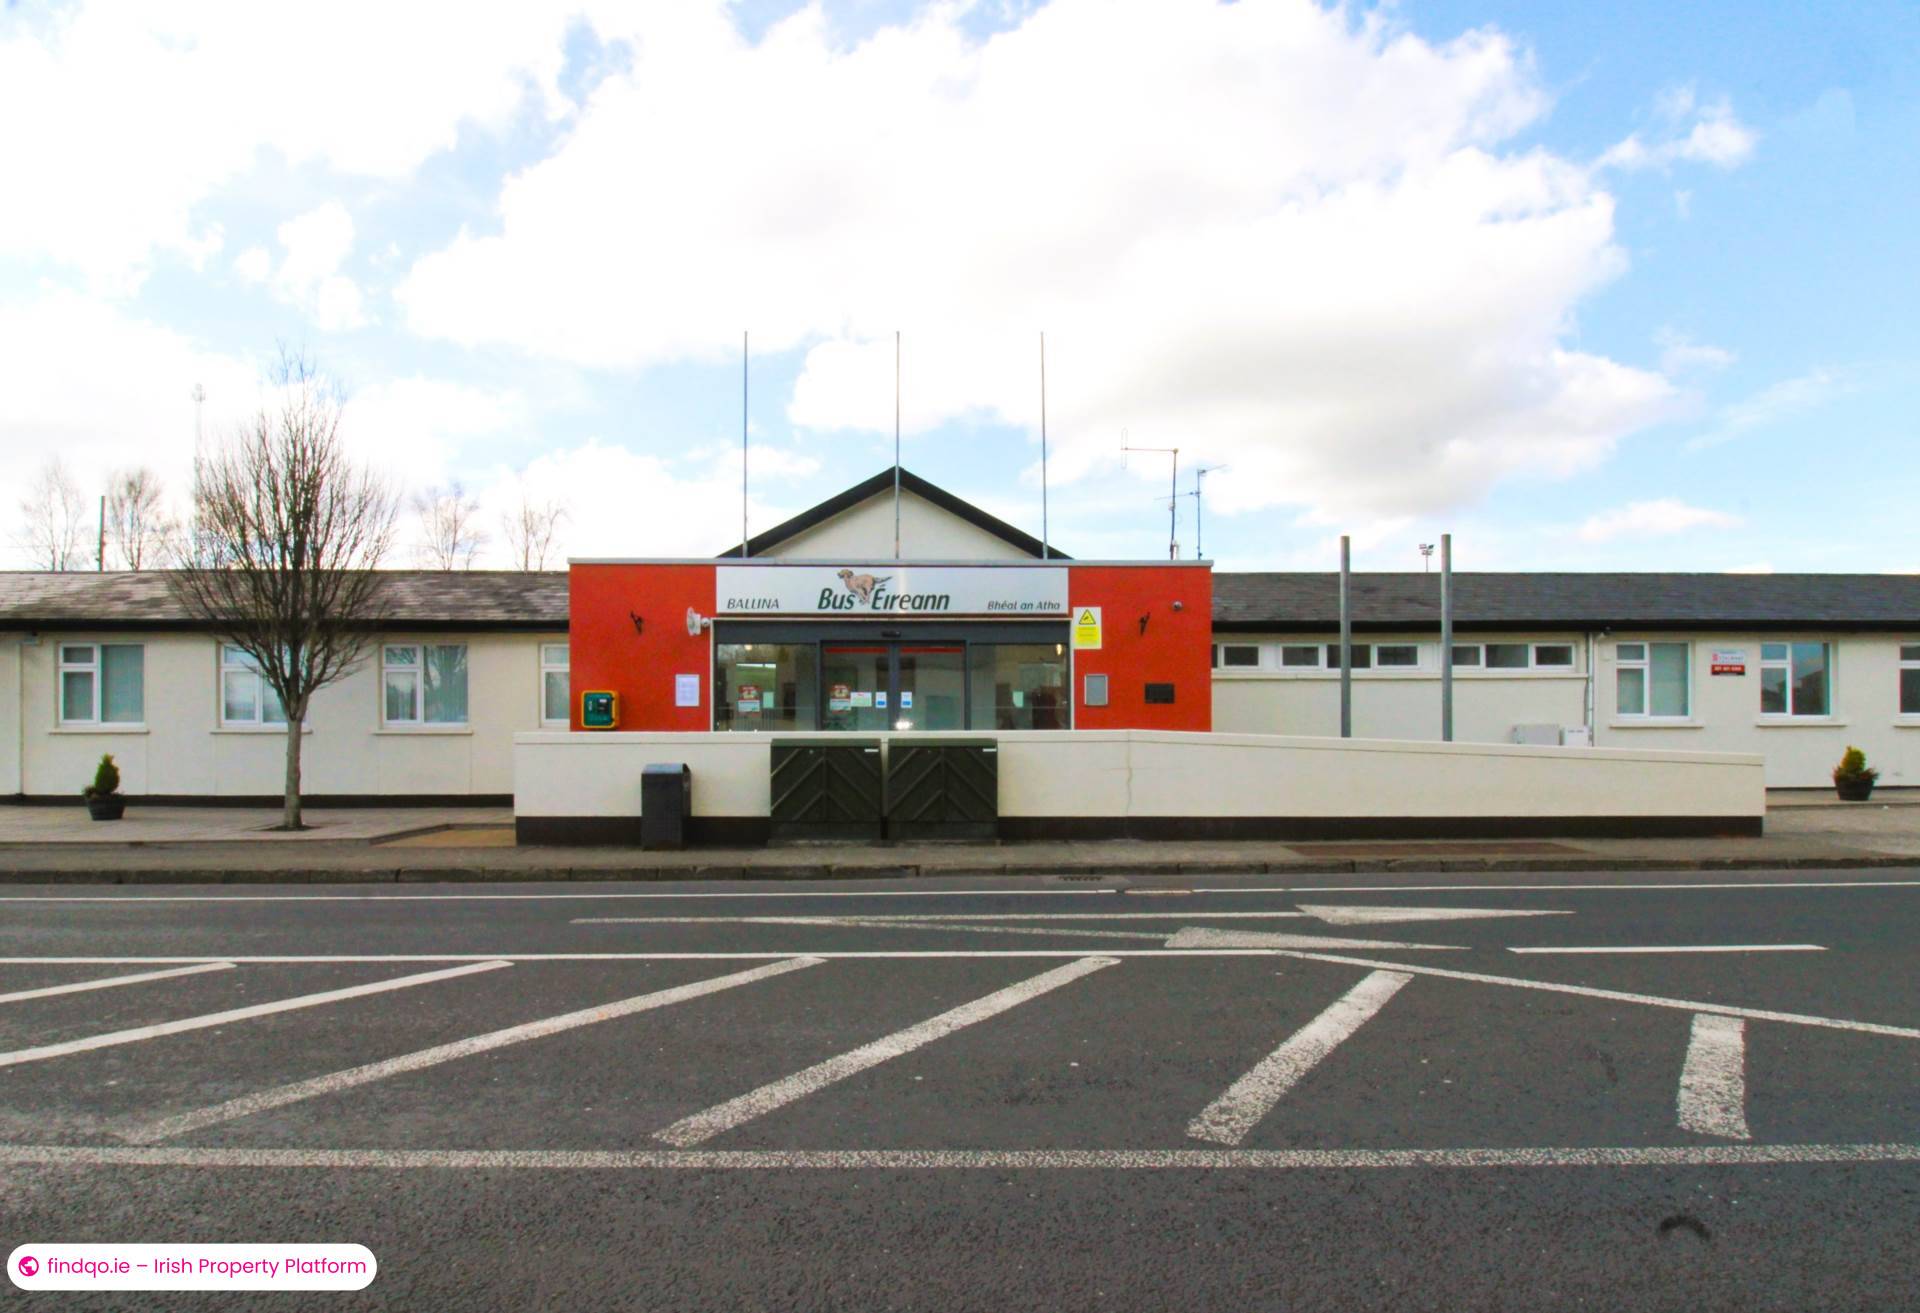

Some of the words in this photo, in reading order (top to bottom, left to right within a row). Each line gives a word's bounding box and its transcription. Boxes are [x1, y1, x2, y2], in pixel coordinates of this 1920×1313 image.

[817, 587, 856, 610] Bus
[871, 584, 950, 610] Éireann
[727, 598, 780, 609] BALLINA
[987, 600, 1018, 610] Bhéal
[1020, 602, 1034, 610] an
